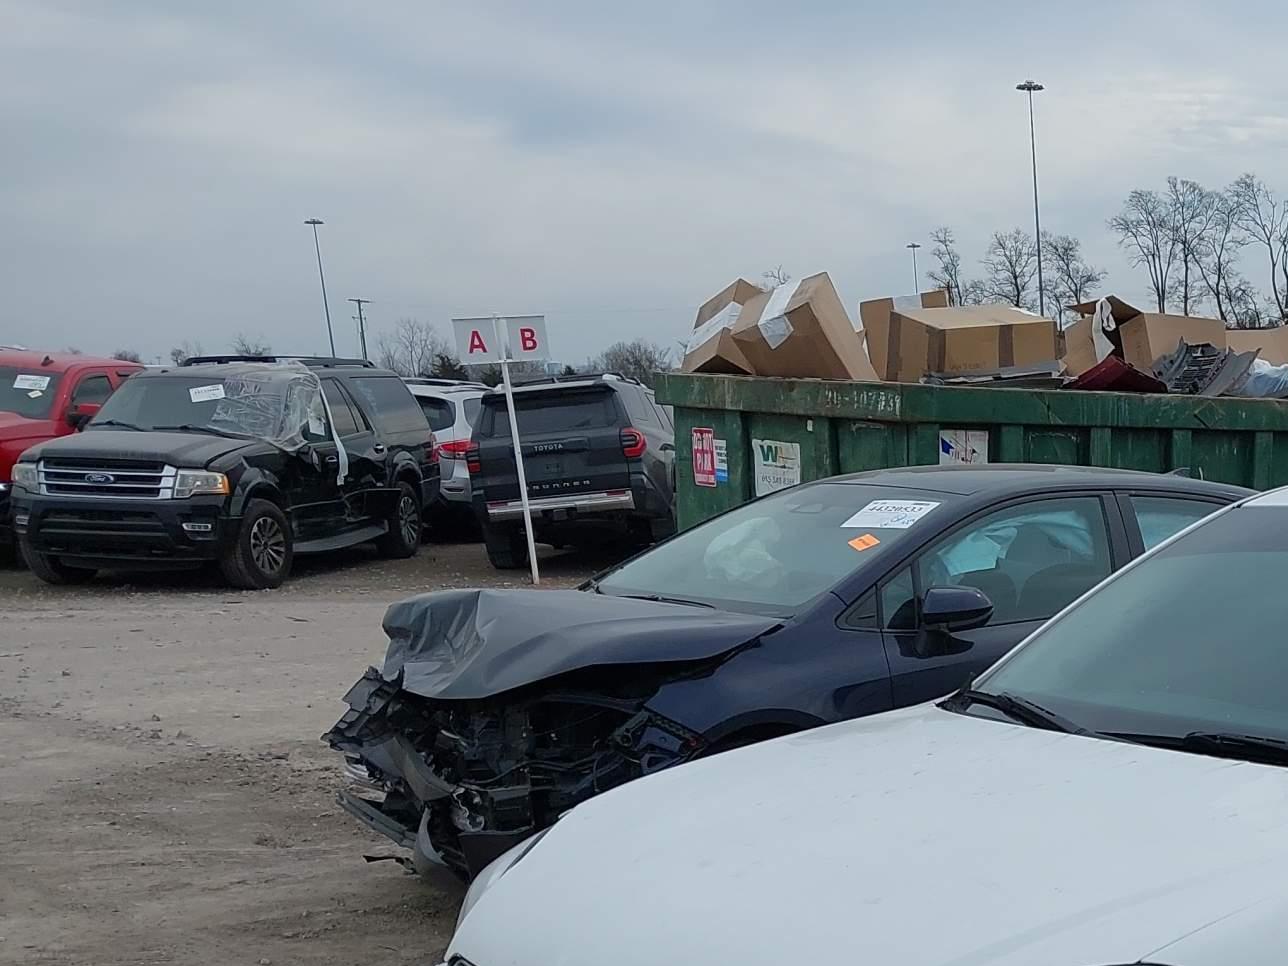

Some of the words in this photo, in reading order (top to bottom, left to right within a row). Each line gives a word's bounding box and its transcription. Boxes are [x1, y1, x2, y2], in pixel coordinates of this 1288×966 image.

[468, 330, 488, 354] A
[519, 328, 538, 352] B
[533, 443, 564, 452] TOYOTA
[89, 474, 106, 482] Ford
[527, 479, 592, 491] RUNNER
